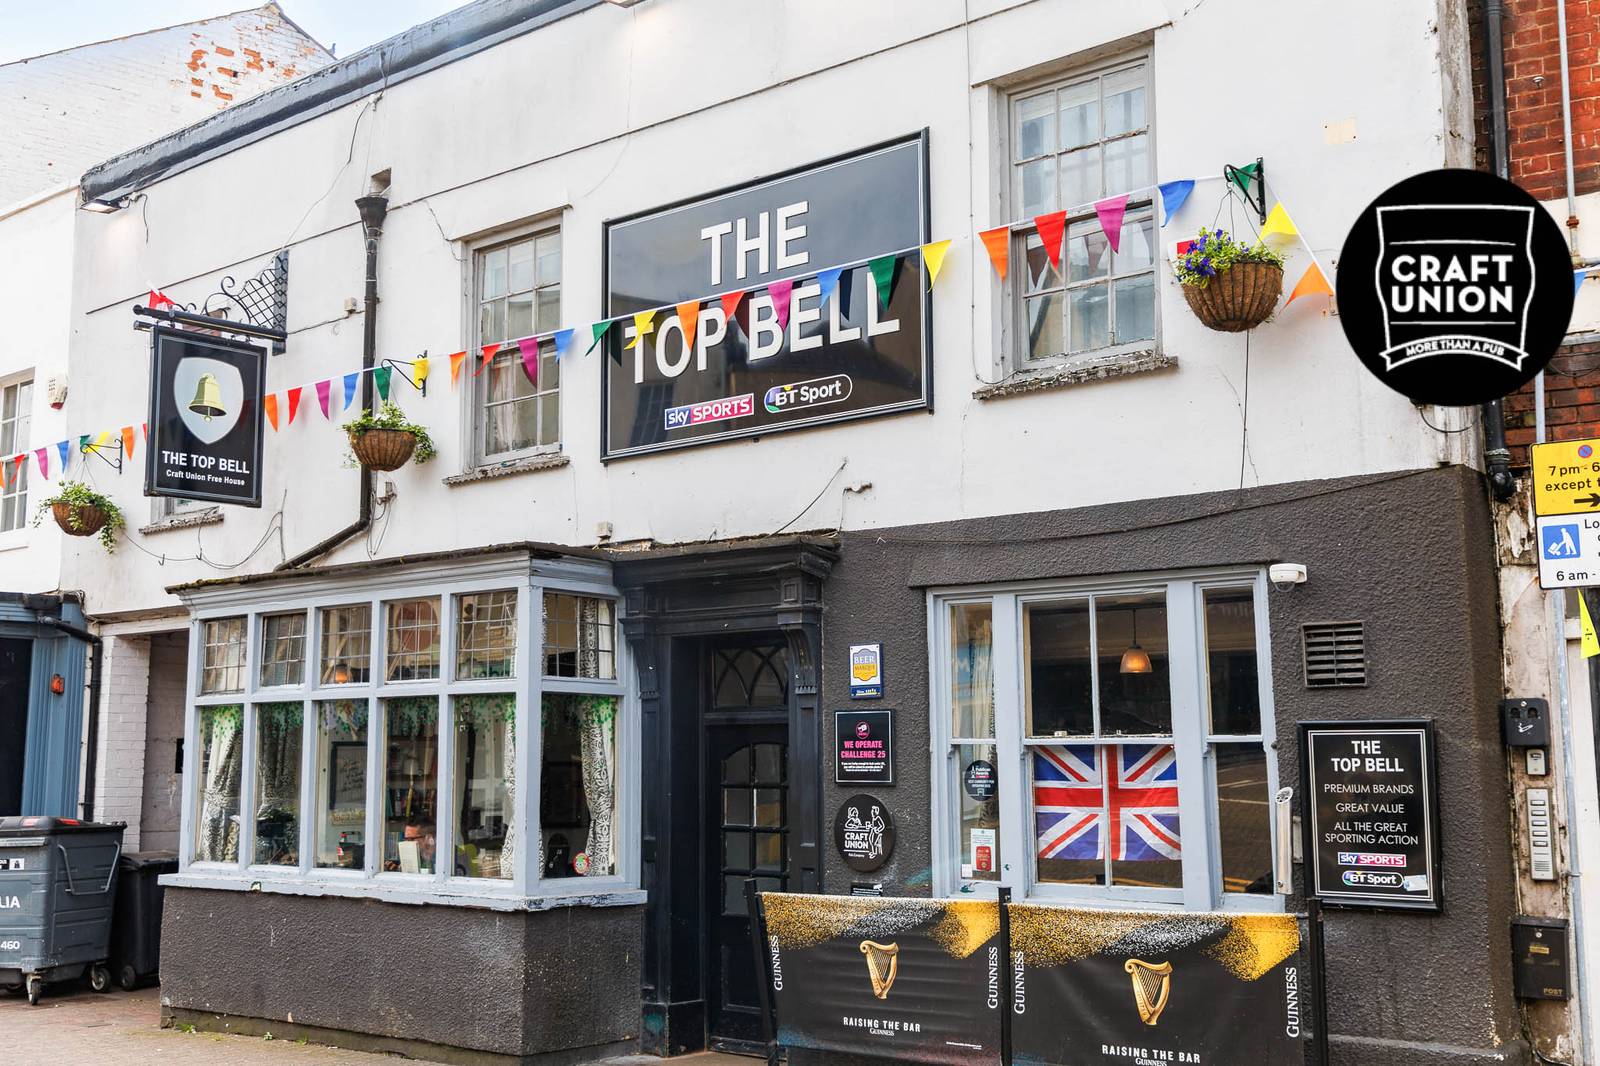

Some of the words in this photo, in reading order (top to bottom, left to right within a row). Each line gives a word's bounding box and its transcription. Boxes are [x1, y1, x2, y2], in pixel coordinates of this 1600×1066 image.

[701, 200, 810, 286] THE
[624, 306, 728, 384] TOP
[749, 271, 900, 361] BELL
[775, 389, 798, 406] BT
[800, 380, 842, 402] Sport
[668, 407, 688, 426] sky
[692, 399, 750, 422] SPORTS
[162, 450, 187, 466] THE
[191, 454, 215, 469] TOP
[219, 458, 250, 474] BELL
[166, 469, 184, 478] Craft
[186, 472, 205, 481] Union
[208, 474, 222, 483] Free
[224, 476, 245, 486] House
[1546, 478, 1592, 492] except
[854, 656, 876, 664] BEER
[844, 740, 854, 748] WE
[855, 740, 882, 748] OPERATE
[1351, 740, 1381, 754] THE
[1331, 758, 1361, 772] TOP
[1365, 758, 1404, 772] BELL
[1324, 784, 1370, 793] PREMIUM
[1373, 784, 1414, 794] BRANDS
[1336, 803, 1369, 812] GREAT
[1371, 804, 1404, 814] VALUE
[1334, 821, 1352, 831] ALL
[1353, 822, 1372, 831] THE
[1374, 822, 1408, 832] GREAT
[845, 832, 868, 841] CRAFT
[1325, 833, 1375, 844] SPORTING
[1378, 834, 1418, 845] ACTION
[844, 841, 868, 849] UNION
[1340, 853, 1357, 864] sky
[1360, 855, 1403, 864] SPORTS
[1350, 874, 1366, 882] BT
[1367, 874, 1396, 884] Sport
[770, 935, 783, 991] GUINNESS
[987, 946, 998, 1009] GUINNESS
[1014, 950, 1025, 1014] GUINNESS
[1543, 988, 1562, 996] POST
[1286, 967, 1300, 1038] GUINNESS
[843, 1016, 880, 1029] RAISING
[883, 1020, 900, 1031] THE
[904, 1022, 921, 1032] BAR
[870, 1027, 894, 1037] GUINNESS
[1102, 1044, 1148, 1058] RAISING
[1152, 1049, 1174, 1061] THE
[1178, 1052, 1200, 1064] BAR
[1136, 1057, 1167, 1066] GUINNESS
